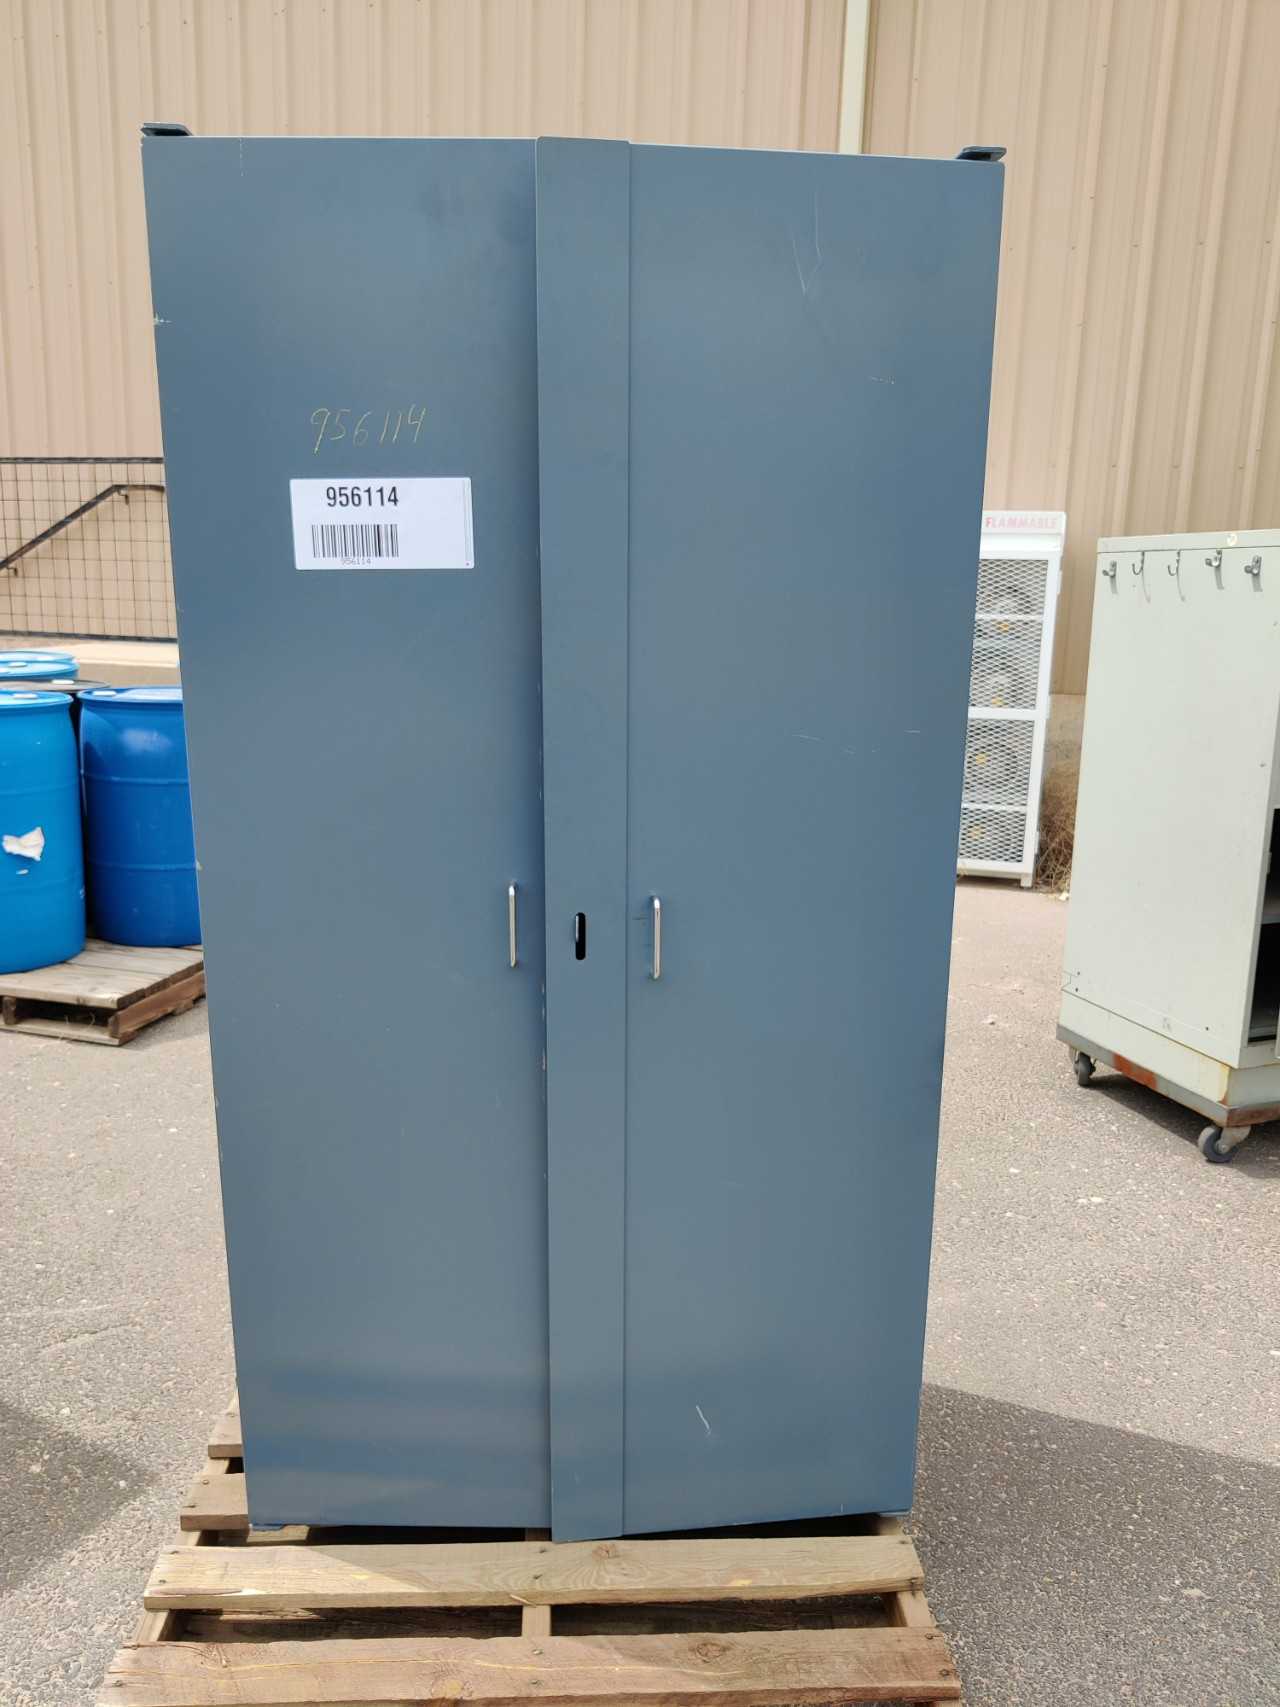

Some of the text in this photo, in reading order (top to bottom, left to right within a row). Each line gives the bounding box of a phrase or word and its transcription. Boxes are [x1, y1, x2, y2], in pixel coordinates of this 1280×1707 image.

[310, 404, 427, 454] 956114
[326, 486, 399, 508] 956114
[985, 516, 1057, 529] FLAMMABLE
